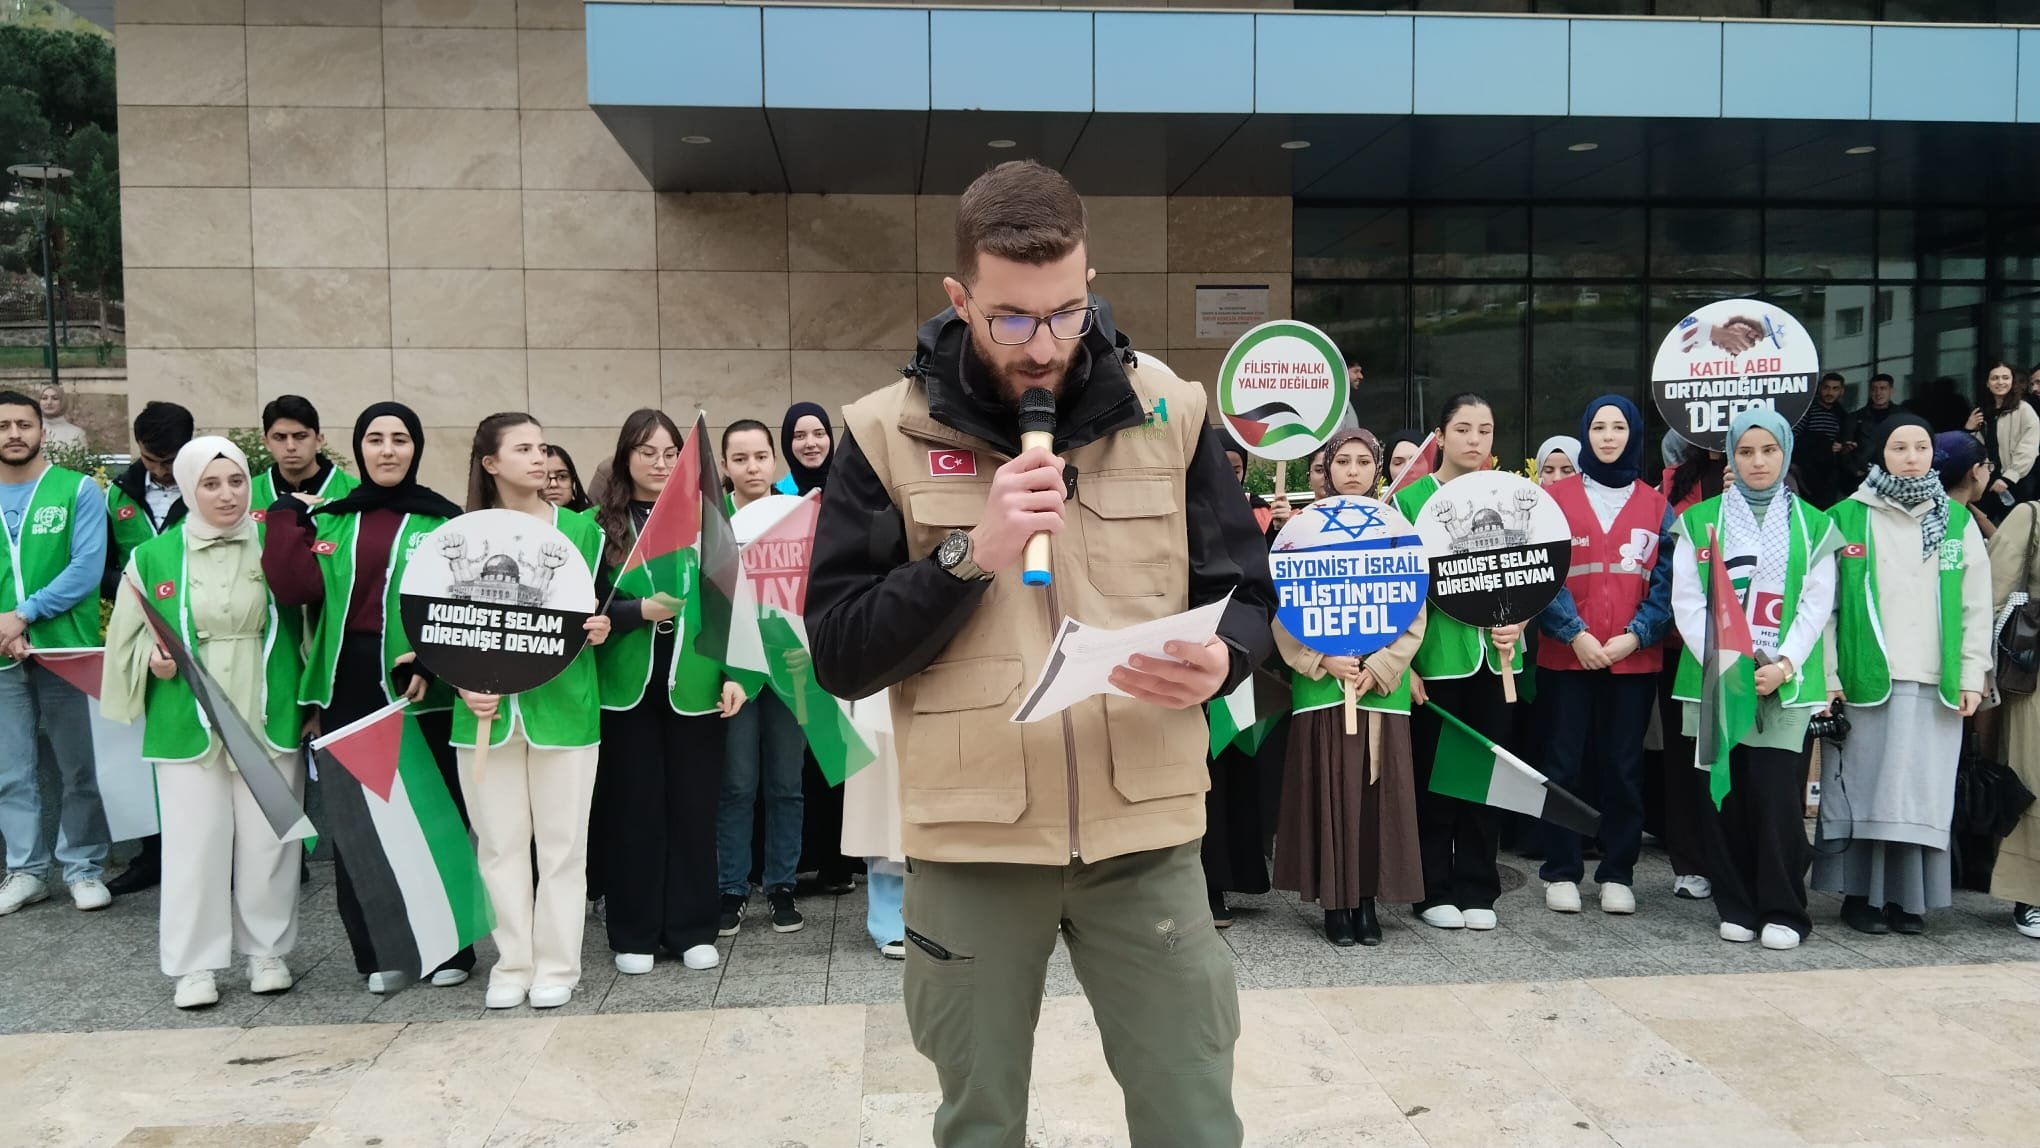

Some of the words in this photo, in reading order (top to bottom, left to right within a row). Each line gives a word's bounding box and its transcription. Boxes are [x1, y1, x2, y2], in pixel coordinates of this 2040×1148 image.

[1244, 360, 1289, 374] FİLİSTİN
[1292, 362, 1324, 374] HALKI
[1690, 357, 1739, 377] KATİL
[1744, 357, 1781, 374] ABD
[1238, 378, 1277, 389] YALNIZ
[1280, 376, 1329, 389] DEĞİLDİR
[1664, 375, 1808, 400] ORTADOĞU'DAN
[1275, 554, 1359, 578] SİYONİST
[1365, 551, 1425, 574] İSRAİL
[1437, 553, 1498, 577] KUDÜS'E
[1499, 548, 1549, 569] SELAM
[1436, 572, 1503, 596] DİRENİŞE
[1504, 566, 1556, 587] DEVAM
[427, 602, 503, 628] KUDÜS'E
[504, 611, 564, 634] SELAM
[1302, 604, 1398, 637] DEFOL
[420, 622, 503, 652] DİRENİŞE
[504, 633, 565, 656] DEVAM
